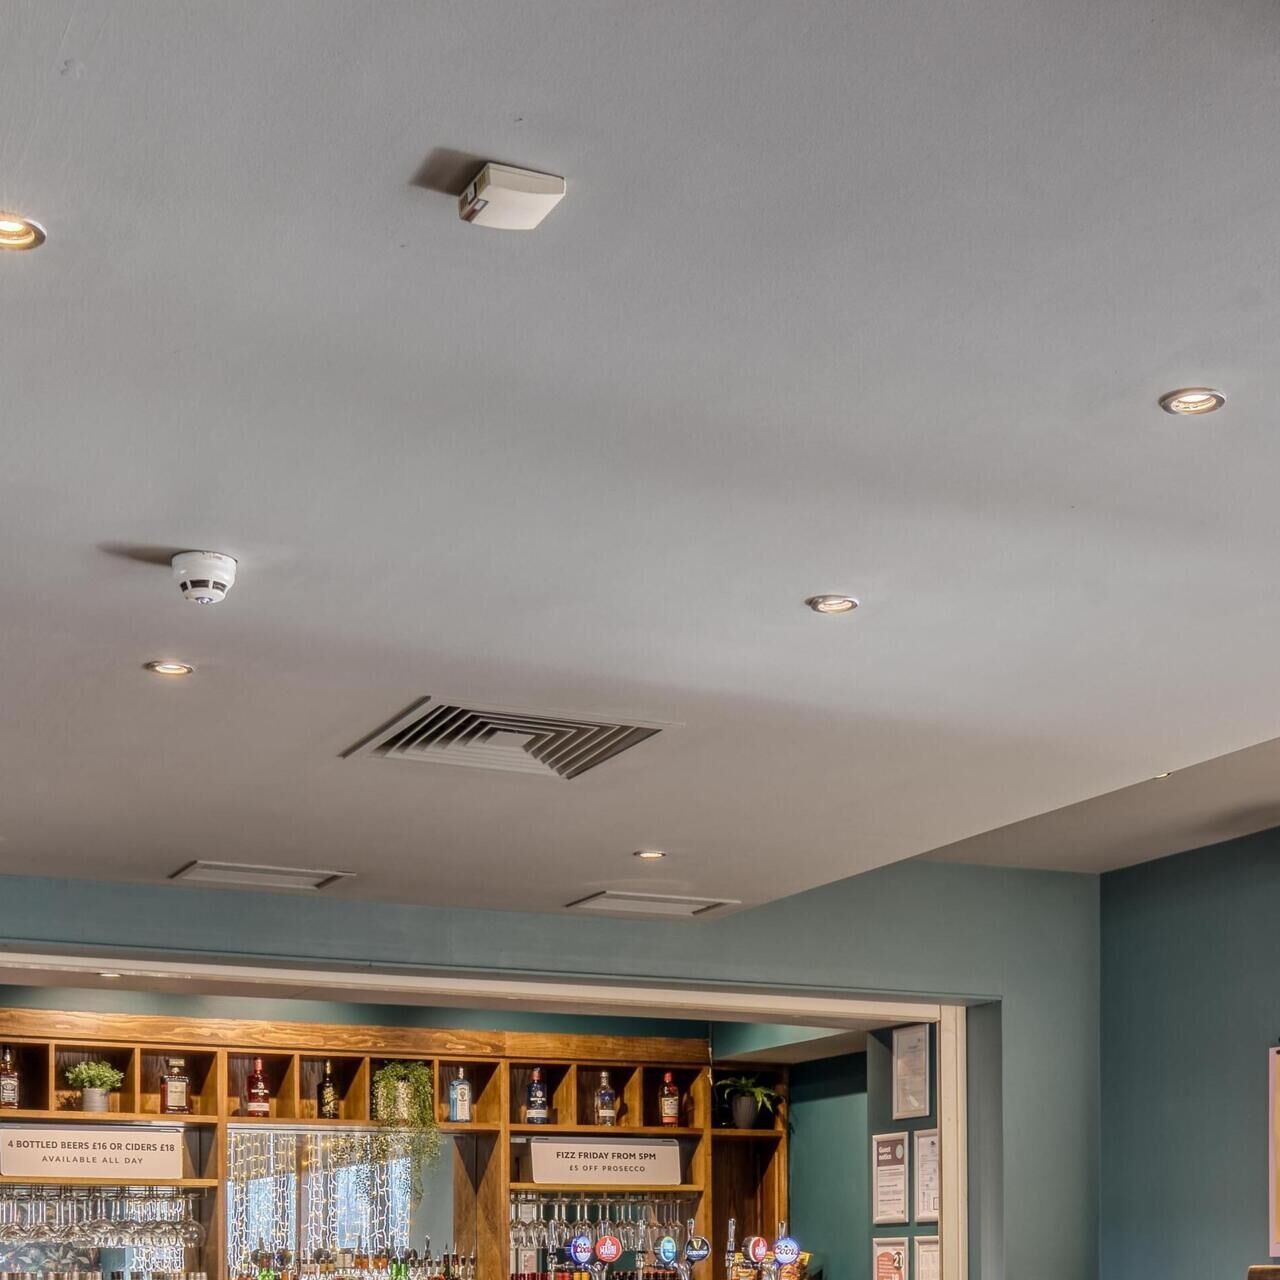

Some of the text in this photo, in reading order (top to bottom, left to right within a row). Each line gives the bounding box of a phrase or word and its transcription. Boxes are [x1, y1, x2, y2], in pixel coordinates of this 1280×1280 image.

[7, 1140, 176, 1152] 4 BOTTLED BEERS £16 OR CIDERS £18
[41, 1155, 144, 1165] AVAILABLE ALL DAY
[556, 1151, 657, 1161] FIZZ FRIDAY FROM 5PM
[569, 1164, 580, 1172] £5
[602, 1165, 646, 1173] PROSECCO
